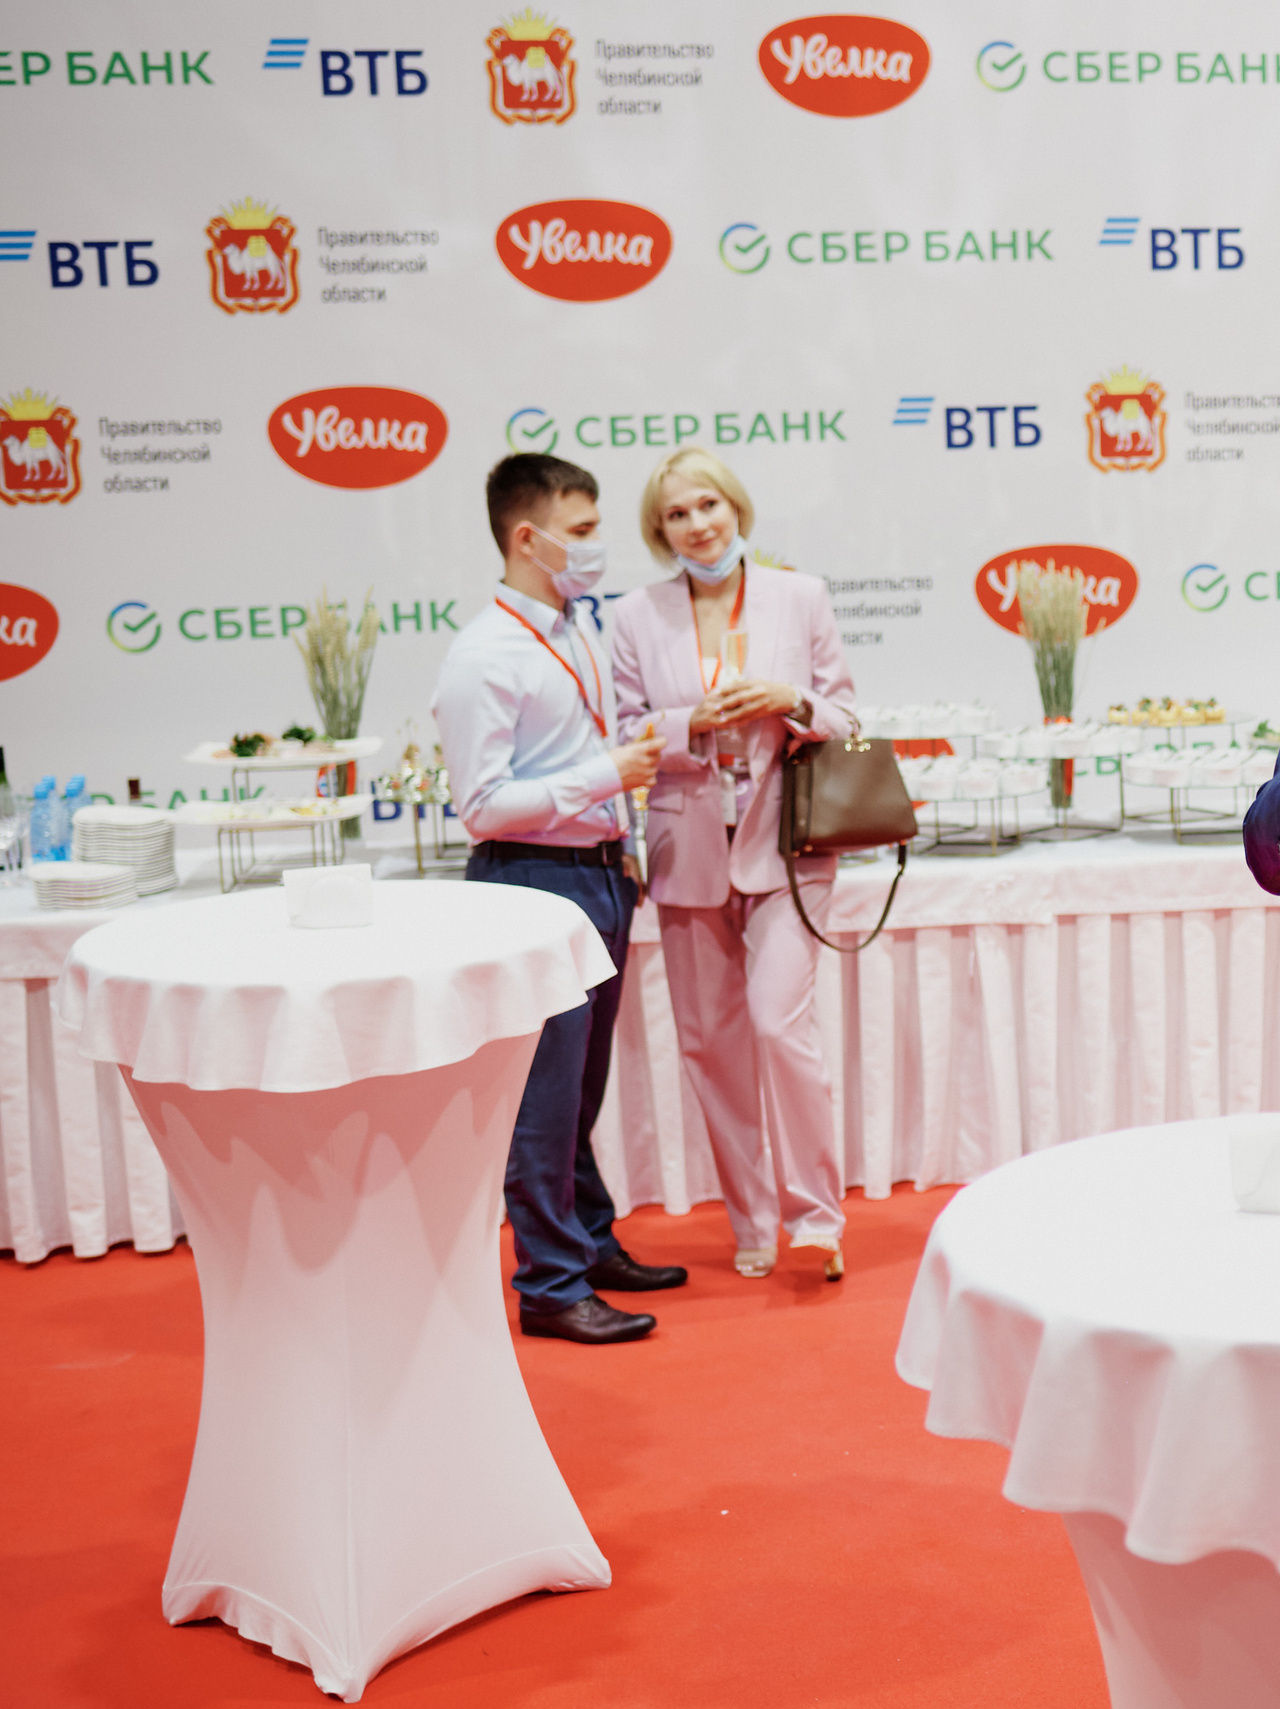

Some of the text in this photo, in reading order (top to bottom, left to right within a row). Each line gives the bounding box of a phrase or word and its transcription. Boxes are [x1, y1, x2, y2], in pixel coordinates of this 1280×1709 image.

[0, 51, 213, 85] ЕР БАНК
[320, 50, 427, 96] ВТБ
[771, 33, 913, 84] Увелка
[1043, 51, 1162, 83] СБЕР
[48, 241, 159, 288] ВТБ
[509, 218, 653, 269] Увелка
[787, 230, 1053, 264] СБЕР БАНК
[1151, 228, 1244, 270] ВТБ
[282, 406, 428, 457] Увелка
[575, 411, 845, 447] СБЕР БАНК
[945, 406, 1041, 449] ВТБ
[178, 606, 307, 641] СБЕР
[833, 600, 922, 620] елябинской
